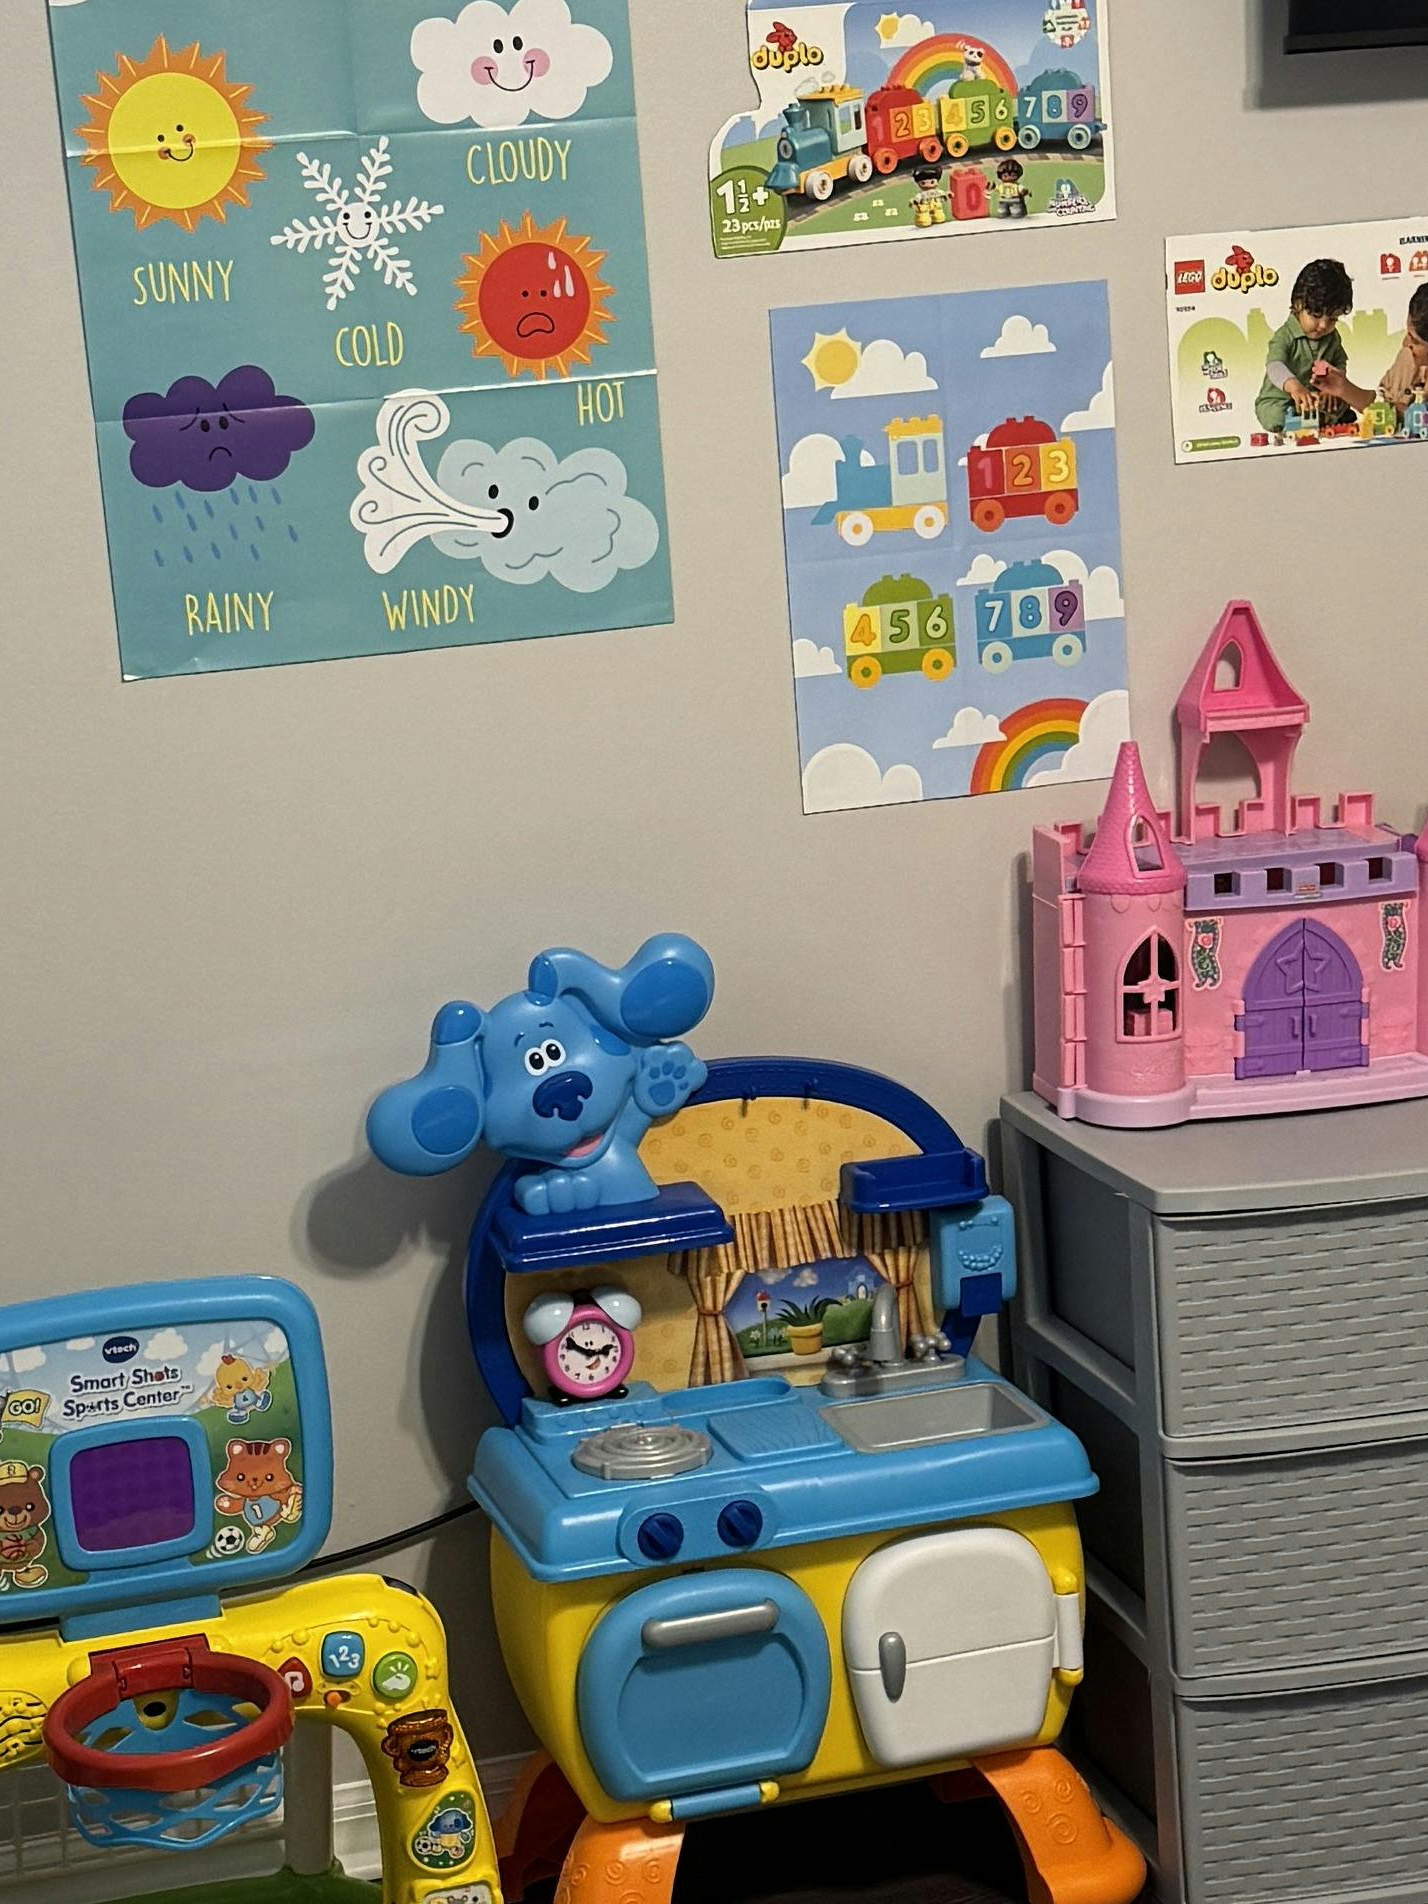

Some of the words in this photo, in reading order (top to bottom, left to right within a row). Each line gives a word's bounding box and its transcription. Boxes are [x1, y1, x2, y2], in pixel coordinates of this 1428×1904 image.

[752, 41, 824, 73] duplo
[467, 139, 571, 185] CLOUDY
[722, 218, 741, 233] 23
[133, 259, 234, 306] SUNNY
[1177, 271, 1202, 284] LEGO
[1211, 264, 1280, 293] duplo
[335, 323, 404, 368] COLD
[577, 381, 624, 426] HOT
[1010, 453, 1036, 488] 2
[1046, 448, 1072, 484] 3
[184, 591, 275, 635] RAINY
[382, 584, 482, 633] WINDY
[850, 612, 877, 646] 4
[888, 608, 911, 643] 5
[924, 604, 948, 639] 6
[984, 598, 1005, 633] 7
[1018, 594, 1042, 630] 8
[1054, 589, 1080, 627] 9
[70, 1372, 125, 1393] Smart
[131, 1365, 179, 1385] Shots
[8, 1397, 41, 1416] GO!
[62, 1398, 120, 1418] Sports
